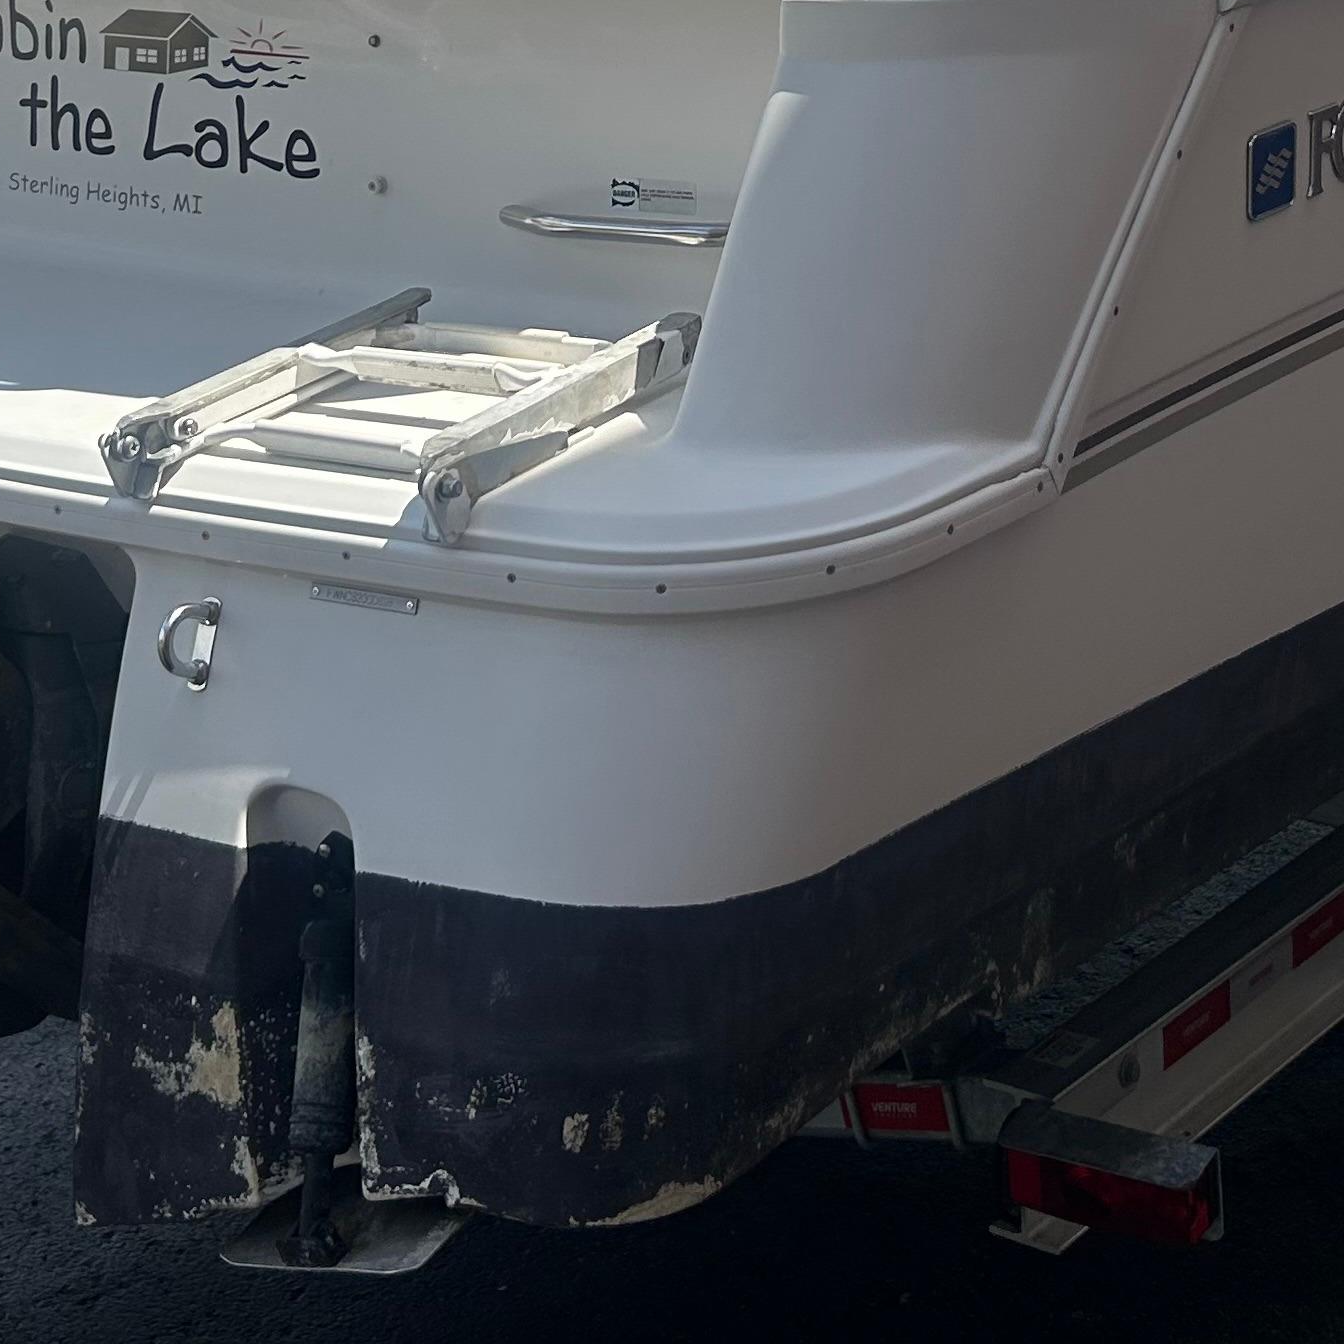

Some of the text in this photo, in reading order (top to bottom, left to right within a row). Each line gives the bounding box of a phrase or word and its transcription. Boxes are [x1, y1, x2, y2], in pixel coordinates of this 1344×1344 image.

[18, 74, 116, 156] the
[142, 81, 321, 180] Lake
[8, 172, 204, 215] Sterling Heights, MI
[871, 1102, 917, 1113] VENTURE
